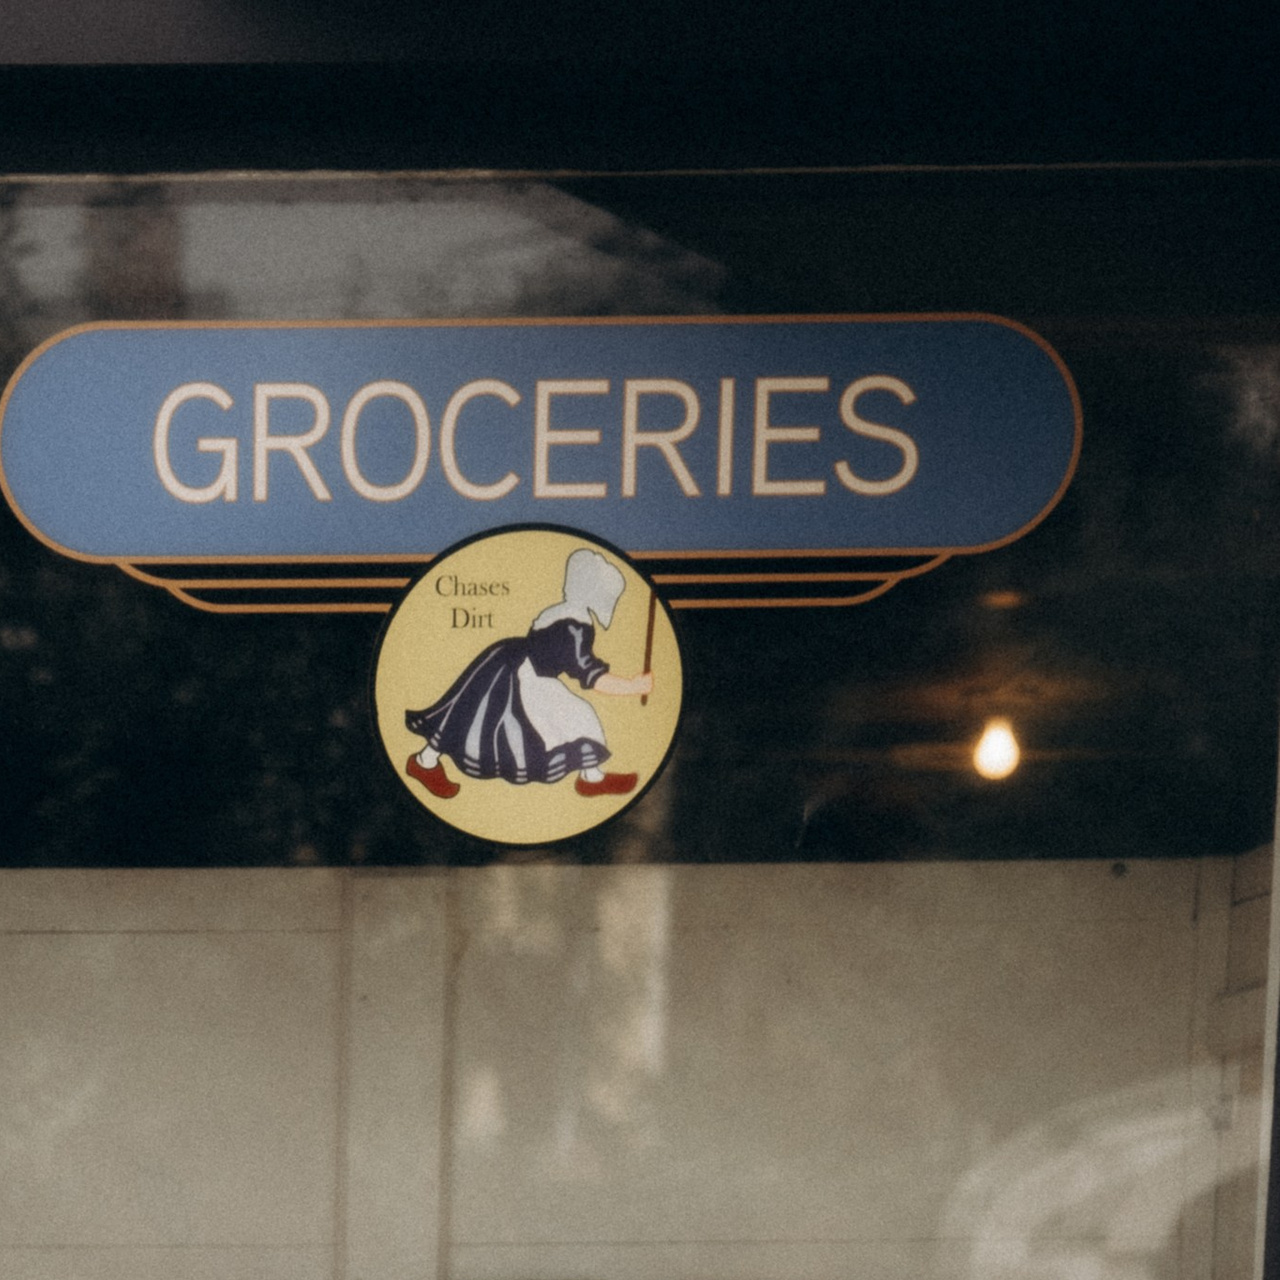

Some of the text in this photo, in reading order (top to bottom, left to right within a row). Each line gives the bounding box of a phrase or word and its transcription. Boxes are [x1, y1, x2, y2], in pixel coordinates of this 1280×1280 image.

[152, 375, 921, 505] GROCERIES
[435, 574, 511, 597] Chases
[451, 607, 494, 629] Dirt
